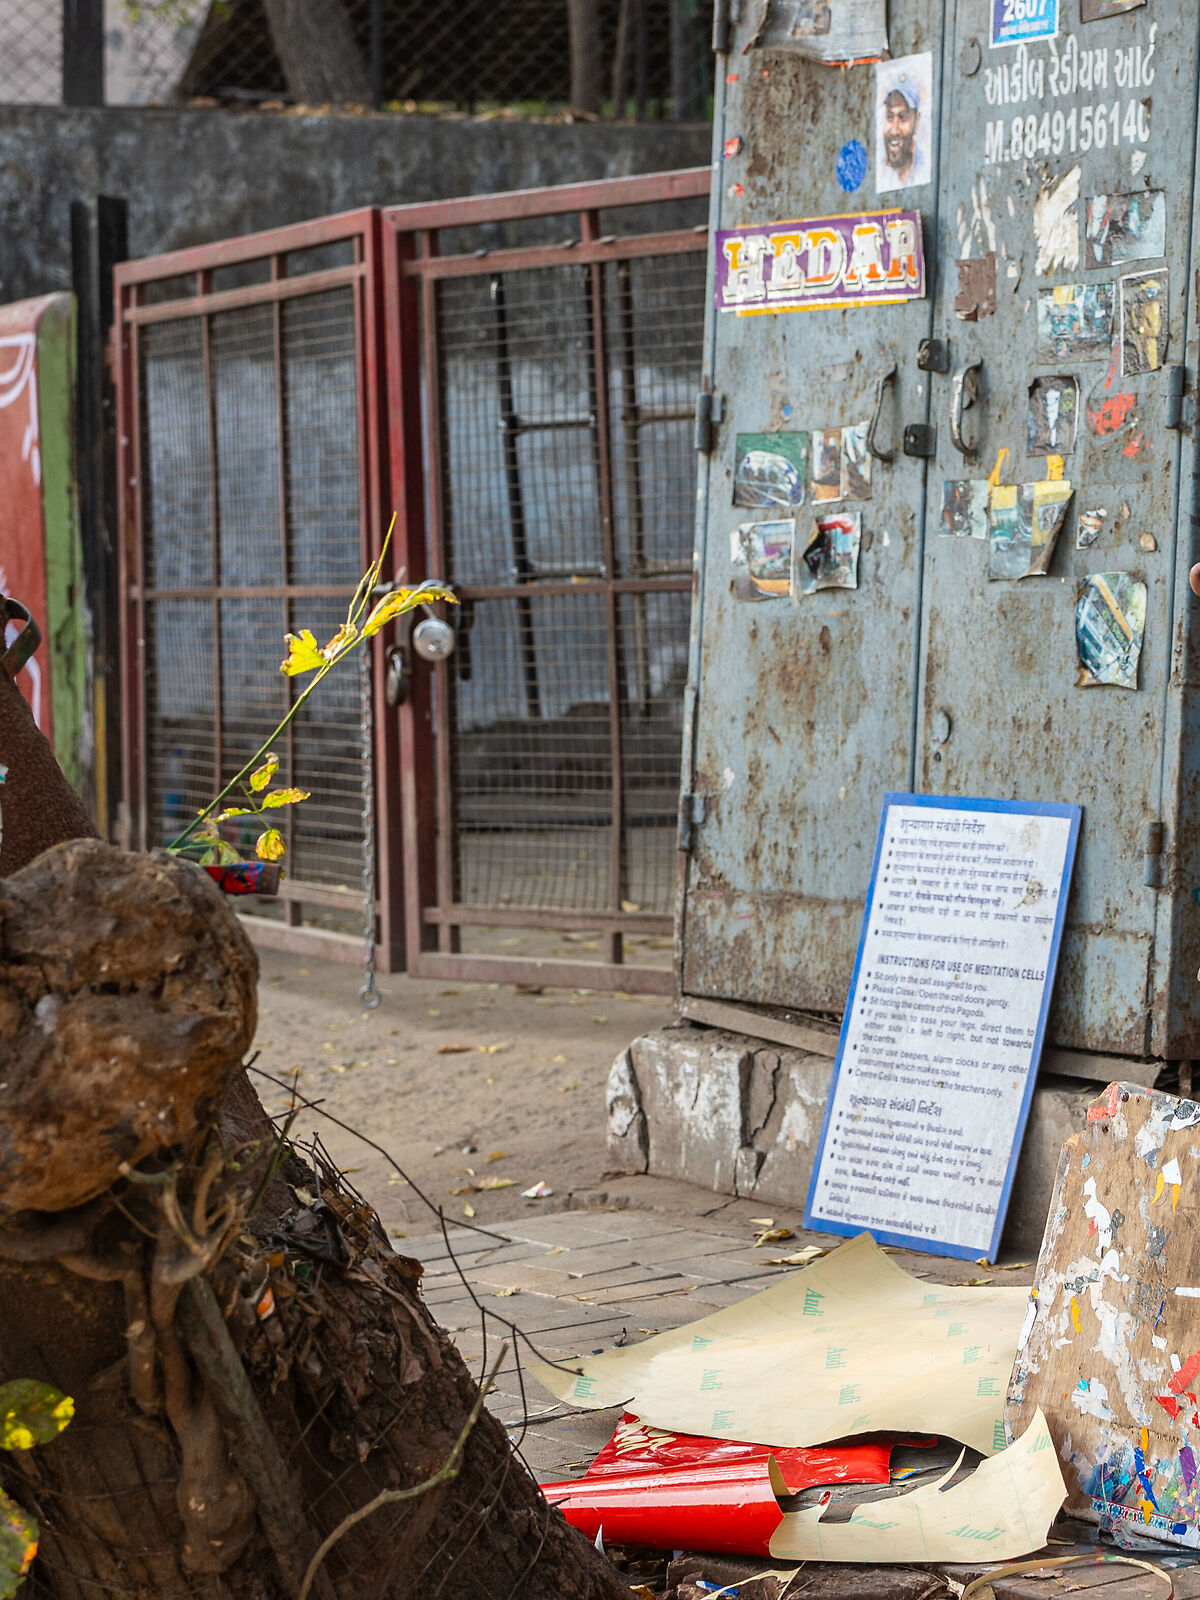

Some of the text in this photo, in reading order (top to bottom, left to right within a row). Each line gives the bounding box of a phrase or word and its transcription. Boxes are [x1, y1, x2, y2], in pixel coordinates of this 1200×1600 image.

[984, 43, 1045, 106] આકીબ
[1114, 22, 1159, 88] આર્ટ
[722, 218, 920, 304] HEDAR
[876, 954, 1044, 980] INSTRUCTIONS FOR USE OF MEDITATION CELLS
[874, 971, 883, 980] Sit
[884, 974, 898, 983] only
[907, 975, 918, 984] the
[919, 977, 932, 985] cell
[932, 977, 965, 990] assigned
[965, 982, 972, 990] to
[869, 996, 878, 1004] Sit
[880, 998, 900, 1010] facing
[901, 1000, 912, 1008] the
[913, 1003, 935, 1012] centre
[936, 1004, 944, 1012] of
[944, 1006, 955, 1014] the
[871, 983, 894, 994] Please
[896, 986, 914, 996] Close
[919, 989, 937, 998] Open
[939, 992, 949, 1000] the
[964, 995, 985, 1004] doors
[864, 1021, 883, 1030] either
[888, 1024, 902, 1032] side
[920, 1027, 932, 1036] left
[935, 1029, 943, 1038] to
[970, 1033, 983, 1043] but
[986, 1036, 999, 1045] not
[1002, 1038, 1031, 1048] towards
[891, 1013, 906, 1021] wish
[940, 1019, 957, 1028] your
[980, 1022, 1002, 1033] direct
[1005, 1025, 1023, 1035] them
[1027, 1028, 1033, 1036] to
[862, 1032, 873, 1041] the
[857, 1057, 894, 1069] instrument
[895, 1063, 915, 1071] which
[917, 1065, 939, 1075] makes
[859, 1044, 869, 1053] Do
[872, 1047, 883, 1055] not
[885, 1049, 898, 1057] use
[932, 1055, 953, 1063] alarm
[955, 1057, 979, 1068] clocks
[981, 1061, 990, 1069] or
[991, 1063, 1005, 1073] any
[1007, 1064, 1027, 1073] other
[854, 1067, 877, 1079] Centre
[900, 1076, 930, 1087] reserved
[954, 1082, 985, 1094] teachers
[802, 1287, 826, 1317] Audi
[825, 1347, 849, 1370] Audi
[573, 1375, 599, 1400] Audi
[700, 1368, 724, 1391] Audi
[976, 1376, 1000, 1396] Audi
[838, 1383, 863, 1406] Audi
[711, 1409, 737, 1431] Audi
[947, 1524, 1006, 1541] Audi
